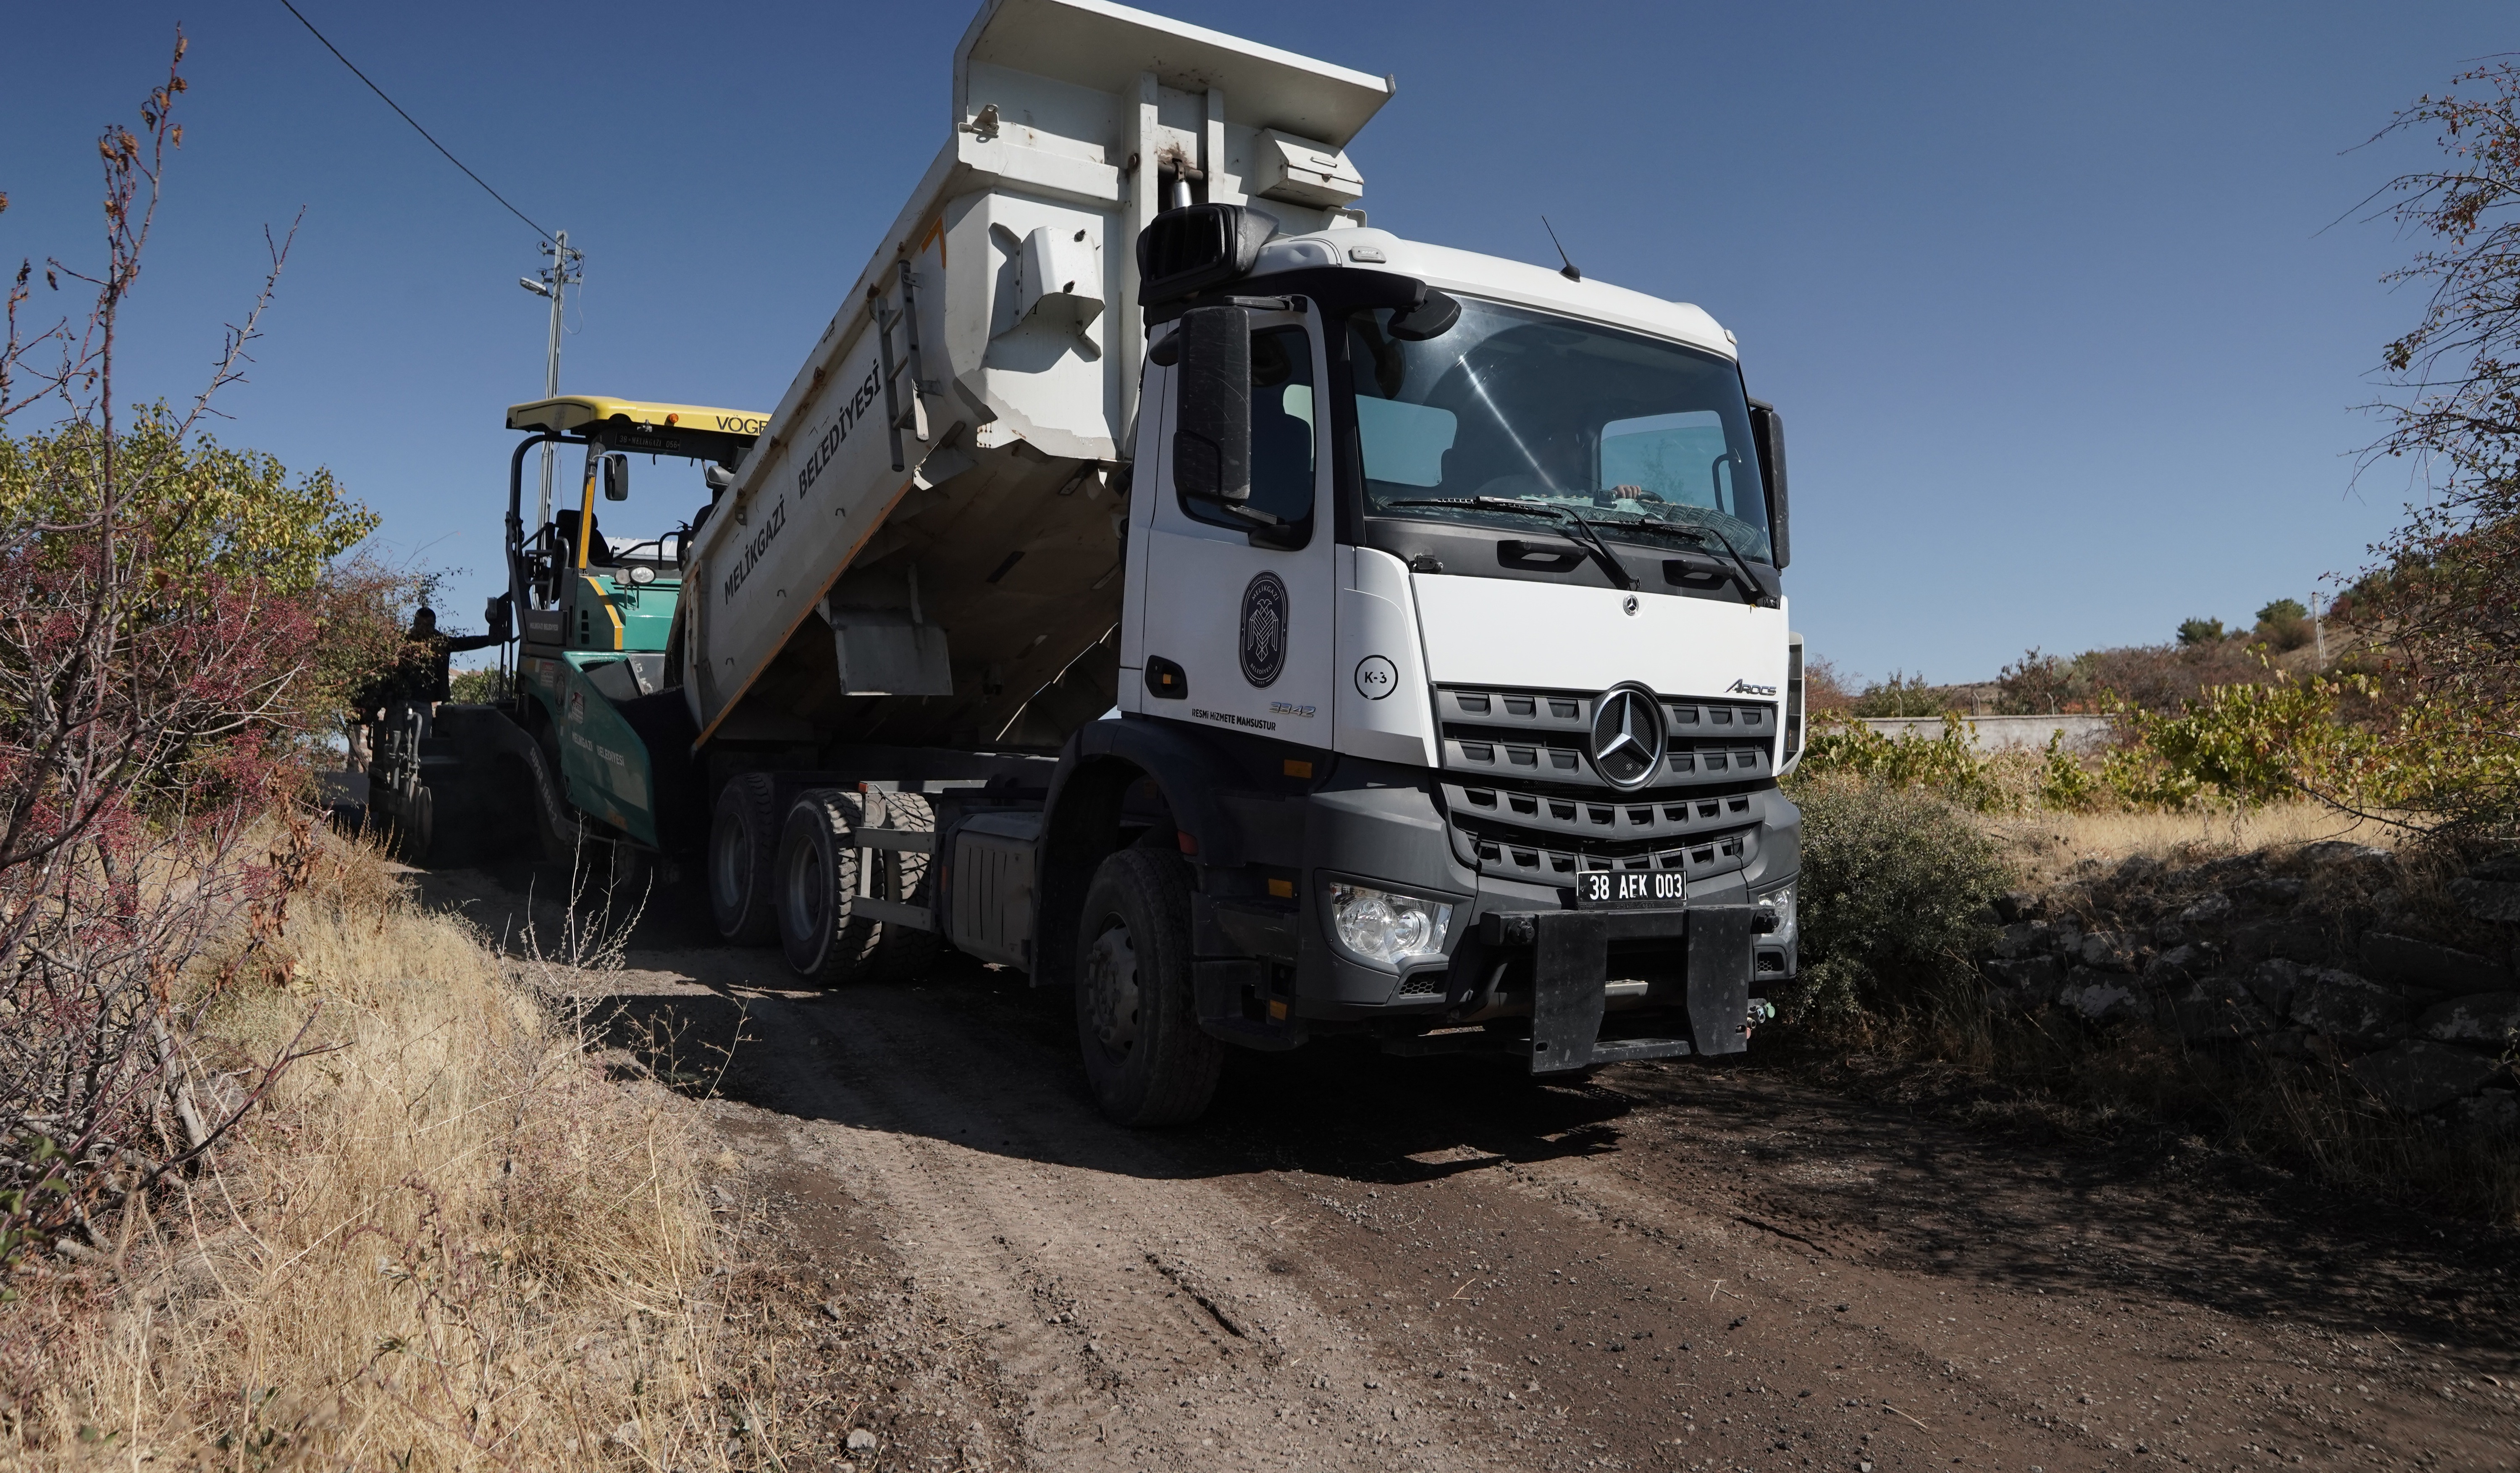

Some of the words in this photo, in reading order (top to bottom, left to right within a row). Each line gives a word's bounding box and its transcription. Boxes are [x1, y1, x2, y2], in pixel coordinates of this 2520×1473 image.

[725, 493, 786, 605] MELİKGAZİ
[798, 358, 881, 500] BELEDİYESİ
[1365, 671, 1387, 684] K-3
[1269, 702, 1316, 718] 3342
[1236, 715, 1276, 731] MAHSUSTUR
[530, 747, 543, 784] SUPER
[1589, 875, 1609, 900] 38
[1656, 873, 1682, 898] 003
